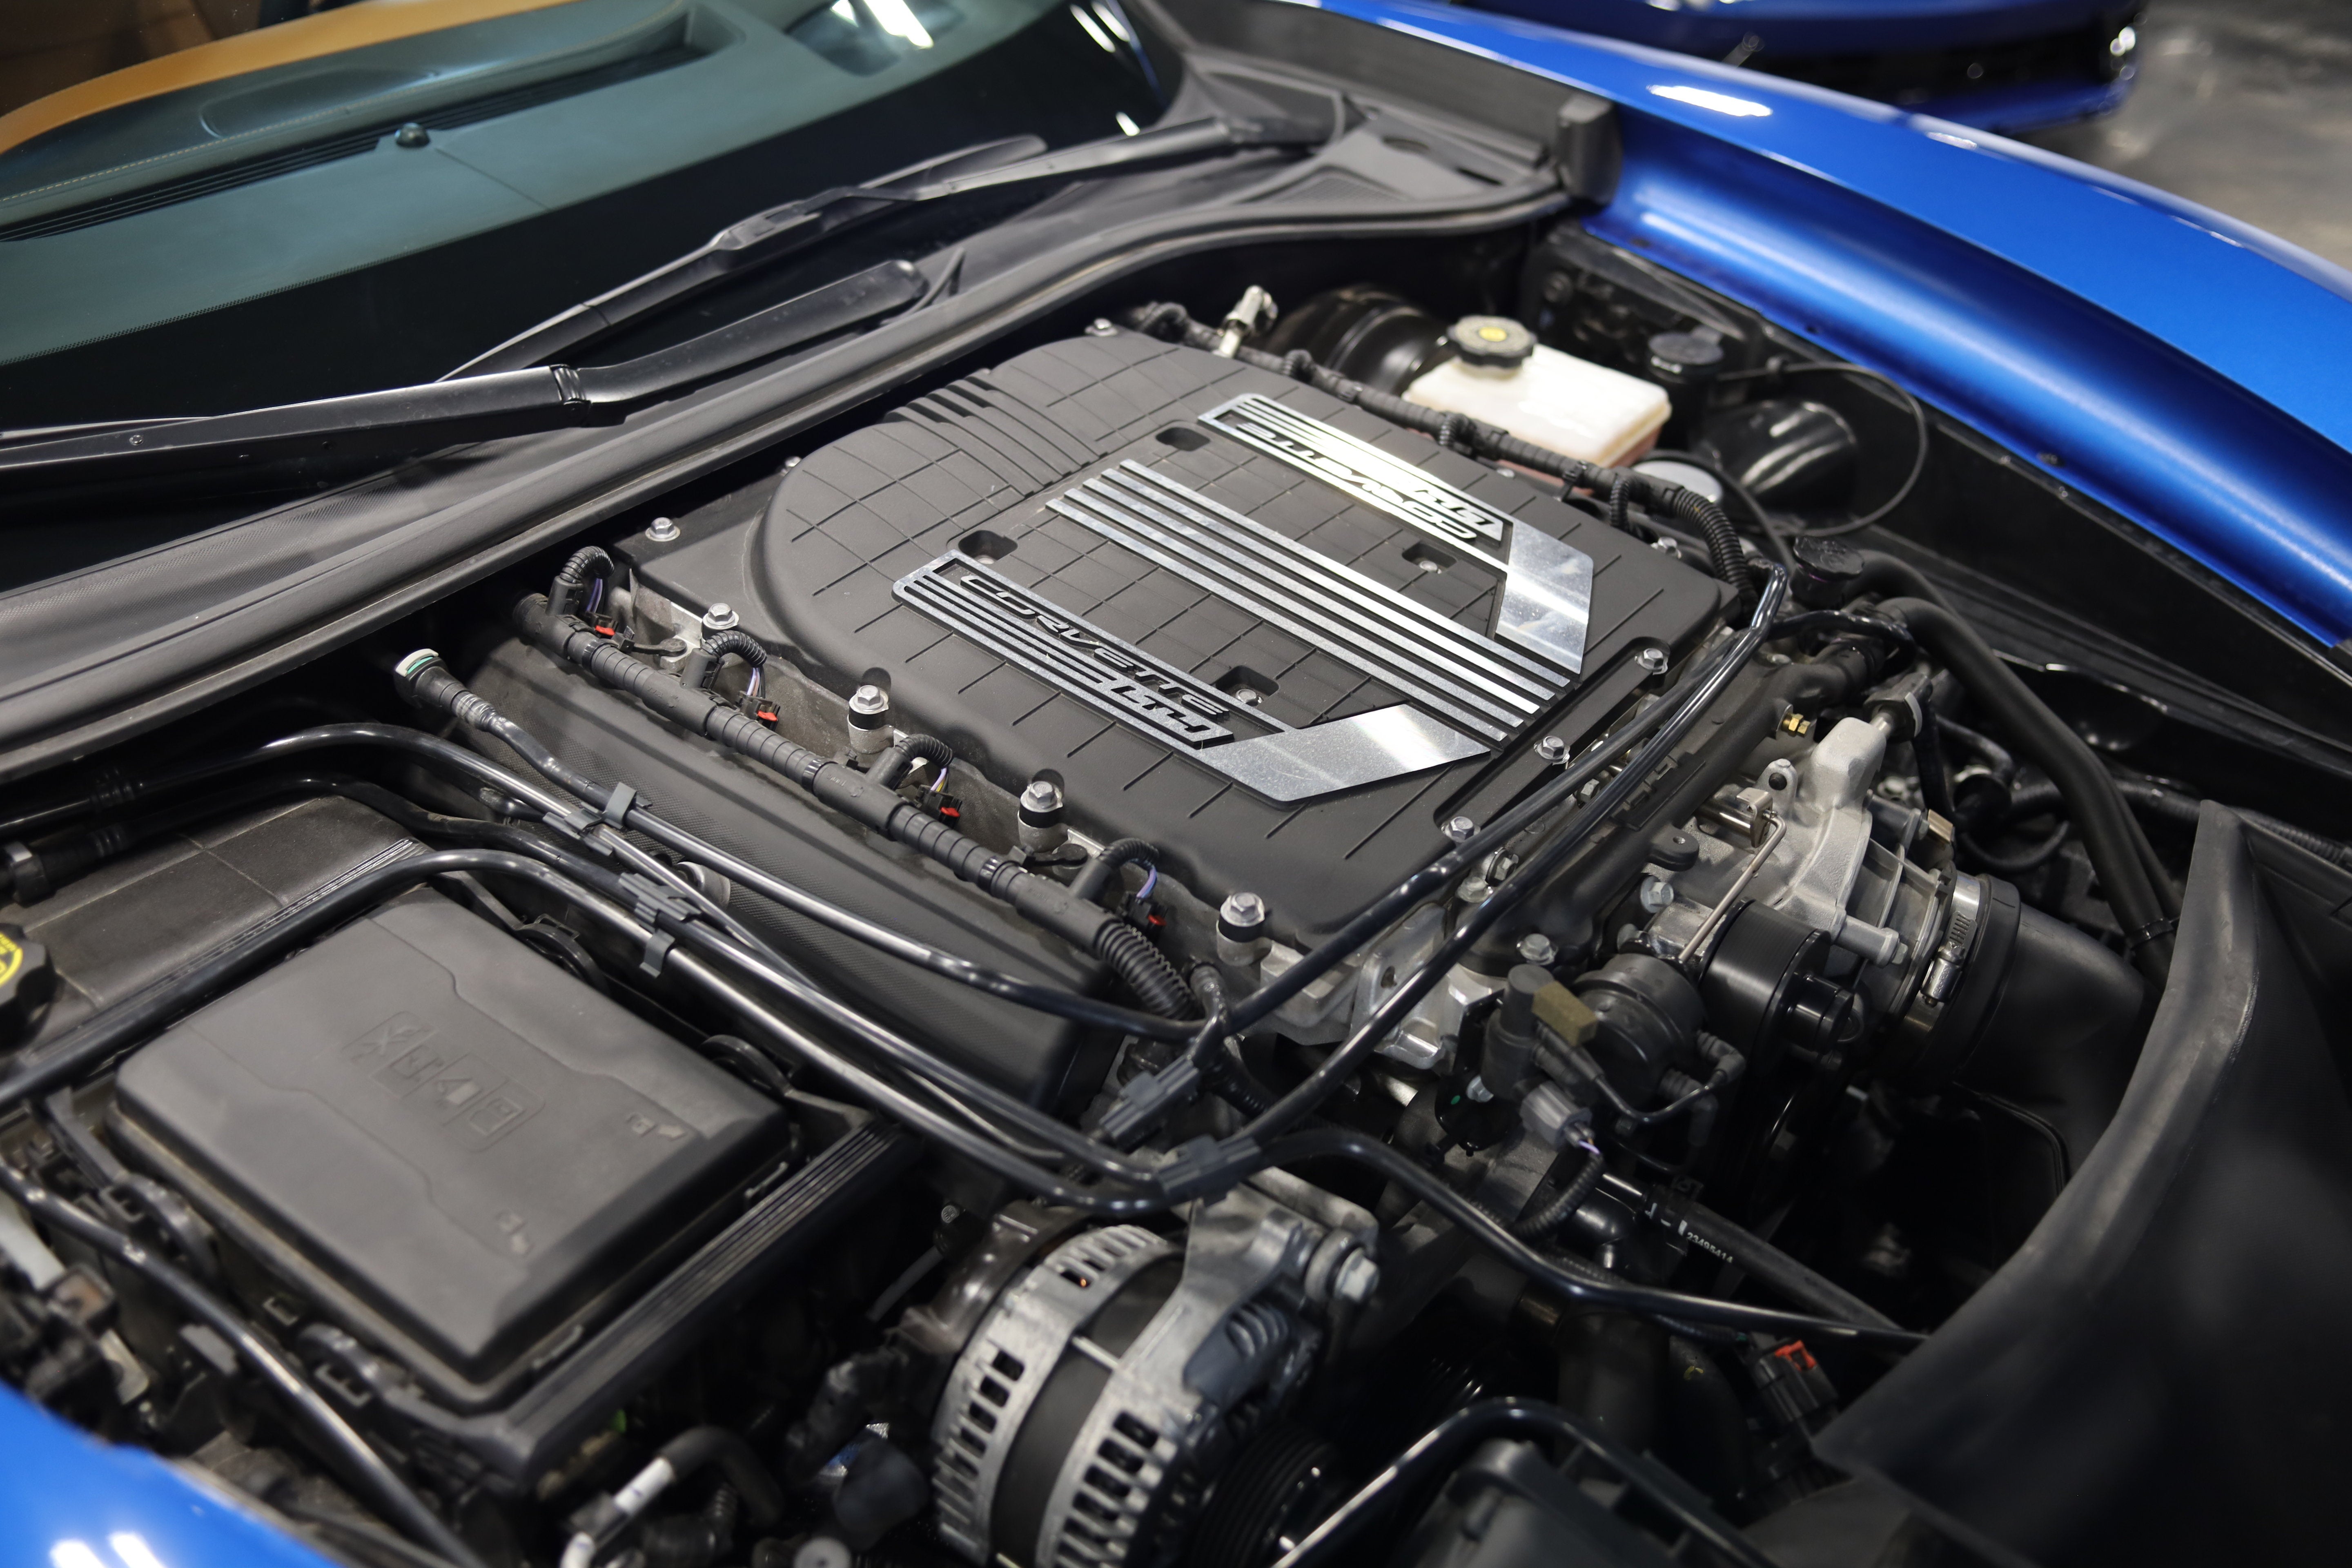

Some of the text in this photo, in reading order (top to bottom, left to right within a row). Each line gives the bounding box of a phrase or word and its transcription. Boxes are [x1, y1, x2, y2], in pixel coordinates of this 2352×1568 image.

[1236, 422, 1477, 539] CORVETTE
[1414, 488, 1496, 527] LT4
[960, 575, 1229, 718] CORVETTE
[1110, 685, 1211, 733] LT4
